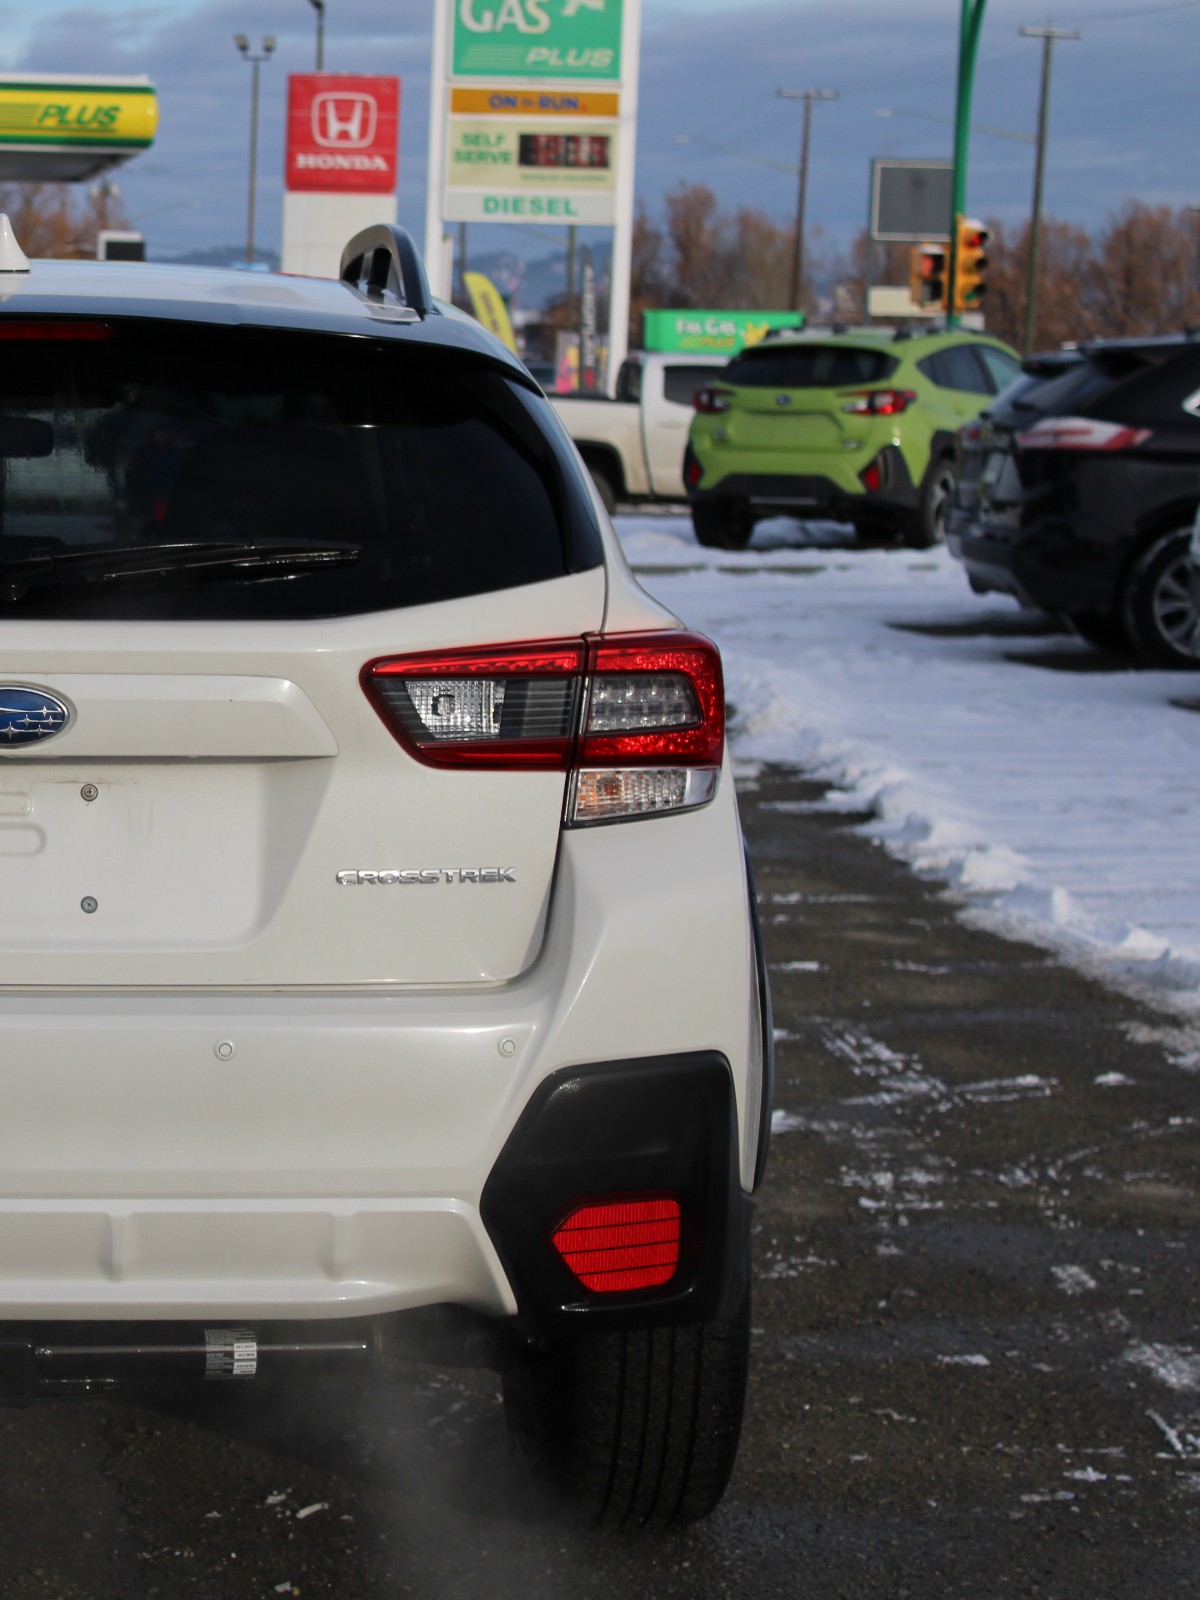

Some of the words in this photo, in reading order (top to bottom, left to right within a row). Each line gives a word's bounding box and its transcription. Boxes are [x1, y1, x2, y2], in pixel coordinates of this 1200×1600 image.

[459, 0, 552, 34] GAS
[526, 47, 614, 67] PLUS
[488, 94, 518, 110] ON
[538, 95, 579, 110] RUN
[38, 103, 121, 127] PLUS
[462, 132, 506, 147] SELF
[296, 153, 389, 171] HONDA
[454, 149, 513, 164] SERVE
[483, 195, 579, 216] DIESEL
[336, 867, 516, 885] CROSSTREK
